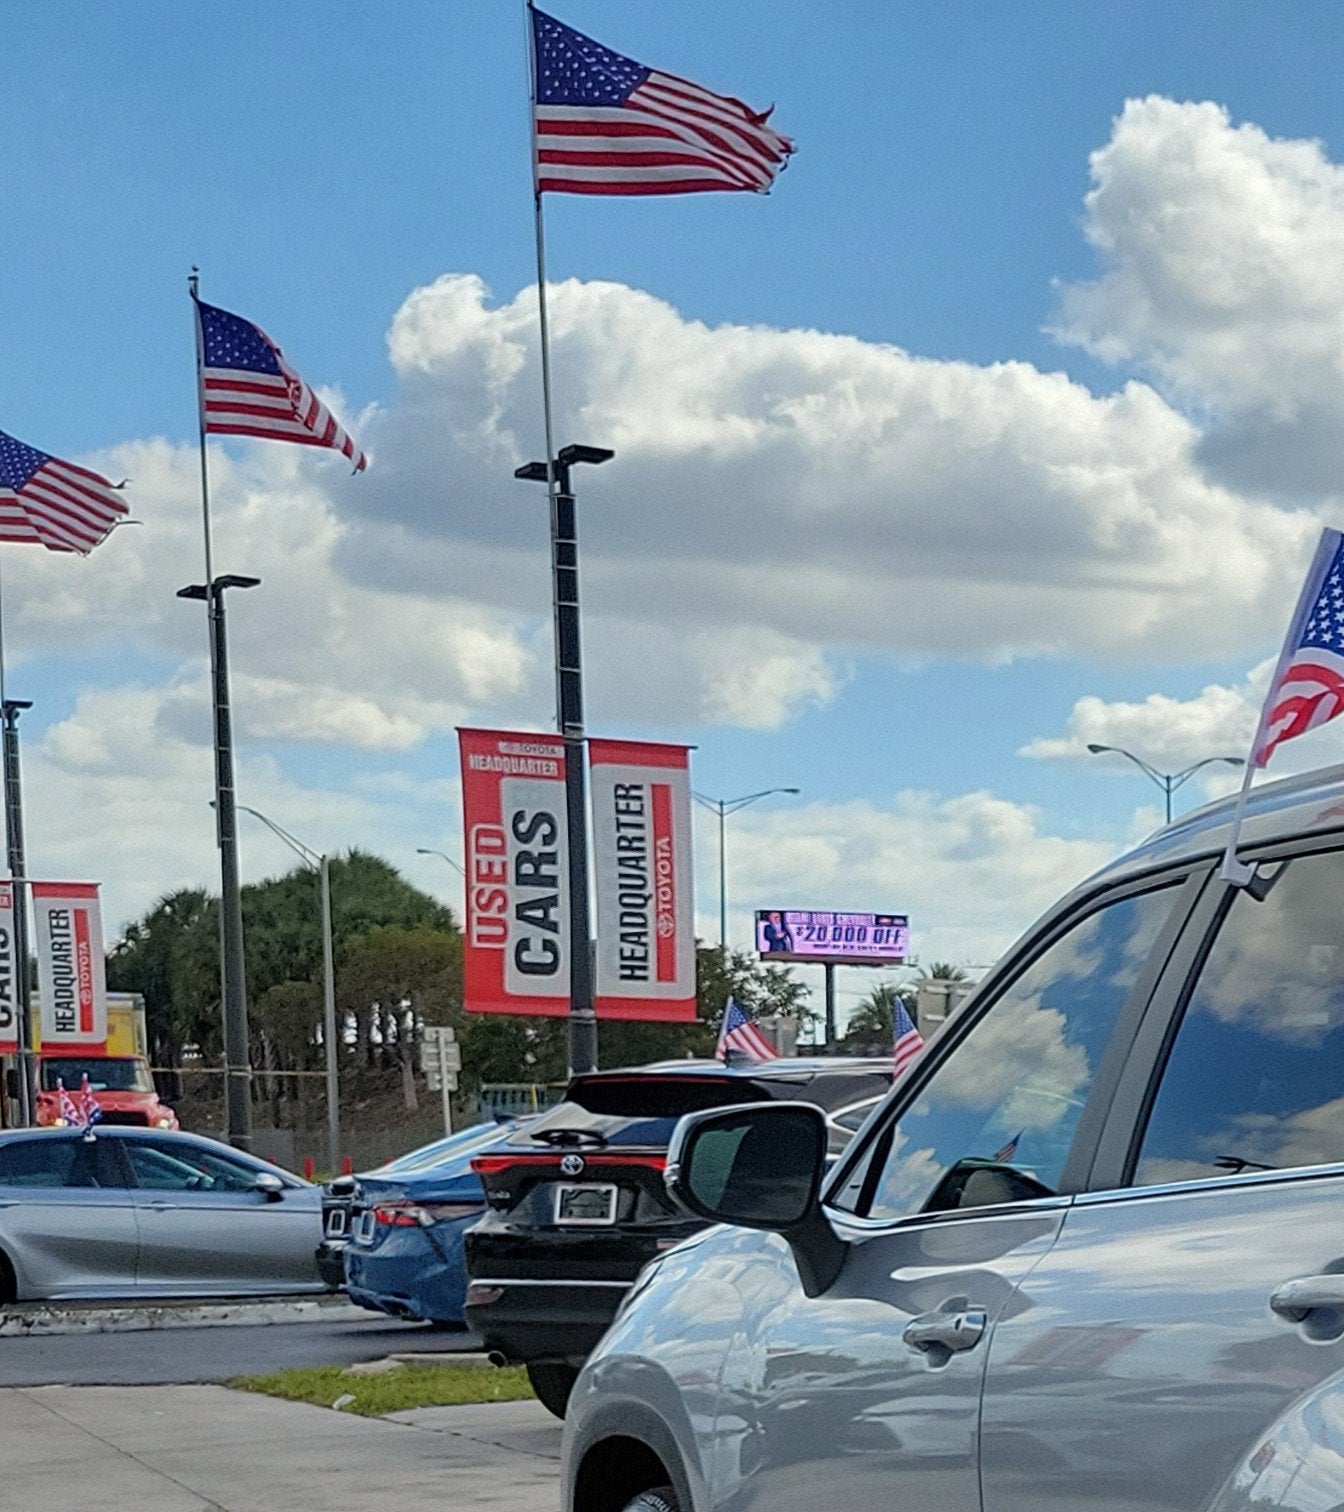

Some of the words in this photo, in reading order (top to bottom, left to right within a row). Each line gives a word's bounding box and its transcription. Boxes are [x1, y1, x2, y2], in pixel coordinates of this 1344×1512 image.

[468, 752, 559, 777] HEADQUARTER
[473, 826, 509, 946] USED
[512, 809, 560, 976] CARS
[614, 782, 653, 982] HEADQUARTER
[656, 836, 673, 913] TOYOTA
[49, 908, 77, 1033] HEADQUARTER
[79, 942, 91, 989] TOYOTA
